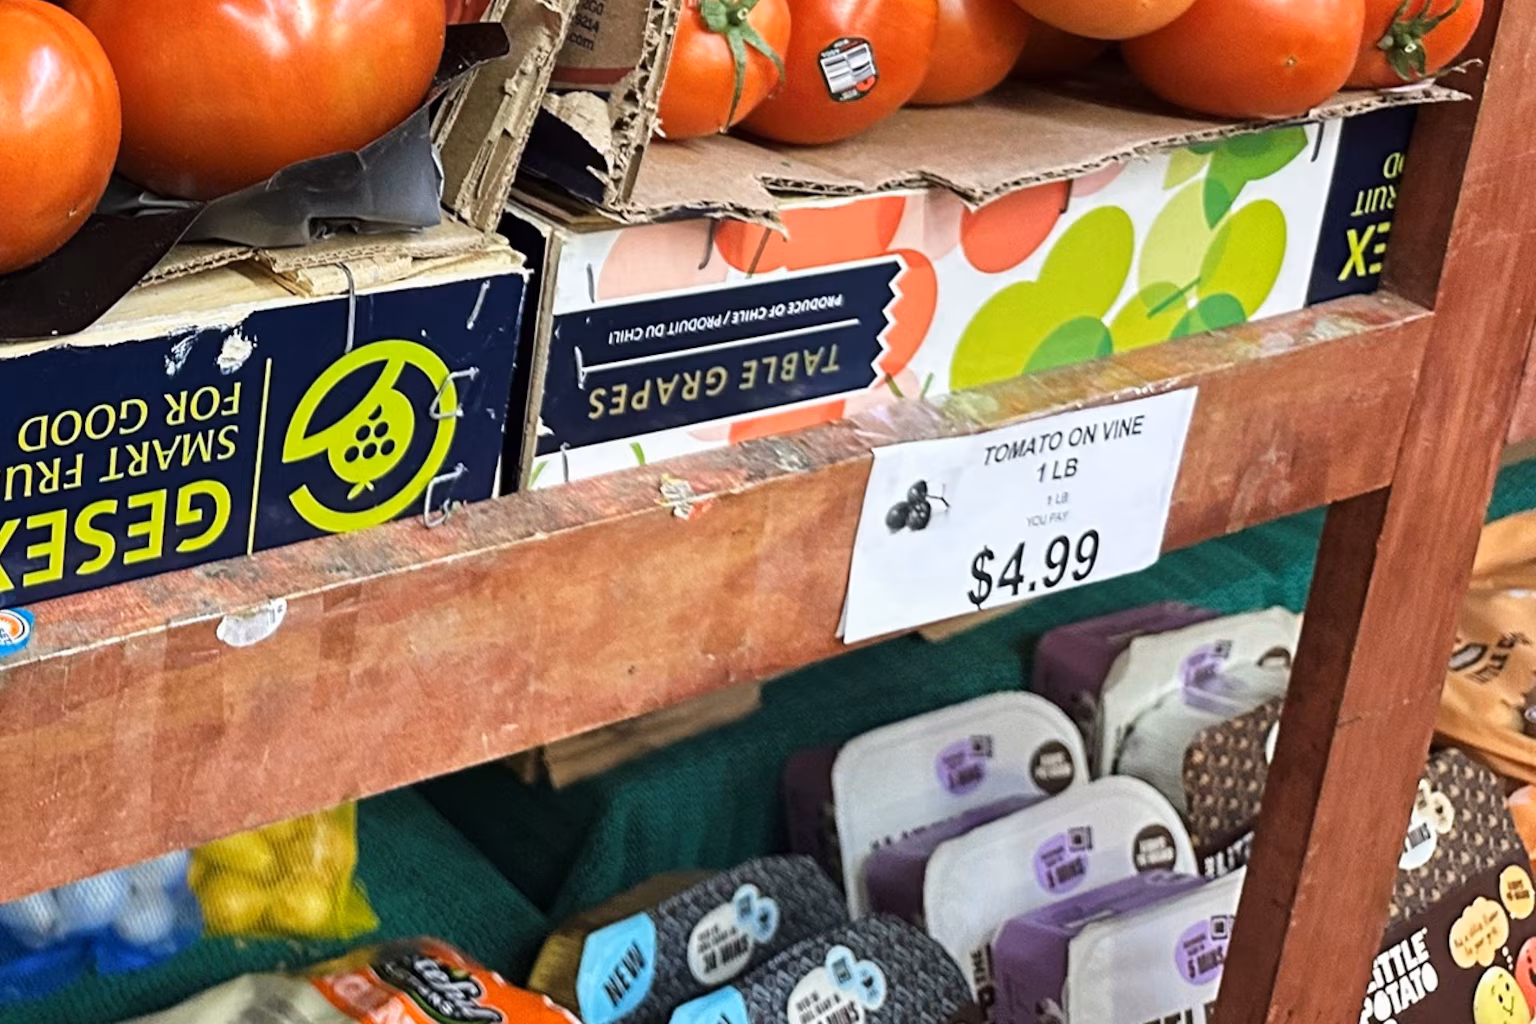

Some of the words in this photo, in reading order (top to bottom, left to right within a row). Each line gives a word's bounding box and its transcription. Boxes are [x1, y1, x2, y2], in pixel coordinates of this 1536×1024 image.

[1350, 184, 1397, 217] RUIT
[732, 307, 766, 324] CHILE
[768, 304, 786, 318] OF
[787, 294, 843, 315] PRODUCE
[608, 327, 644, 345] CHILI
[645, 324, 665, 340] DU
[667, 313, 722, 336] PRODUIT
[739, 343, 840, 391] TABLE
[163, 382, 242, 423] FOR
[588, 365, 729, 419] GRAPES
[18, 399, 147, 452] GOOD
[983, 432, 1063, 467] TOMATO
[1068, 423, 1096, 446] ON
[1103, 414, 1146, 440] VINE
[99, 425, 239, 482] SMART
[1037, 465, 1046, 483] 1
[1052, 458, 1078, 482] LB
[1055, 492, 1069, 505] LB
[1026, 514, 1048, 528] YOU
[1049, 510, 1069, 526] PAY
[967, 528, 1100, 609] $4.99
[602, 939, 646, 1008] NEW
[1367, 929, 1431, 994] ITTLE
